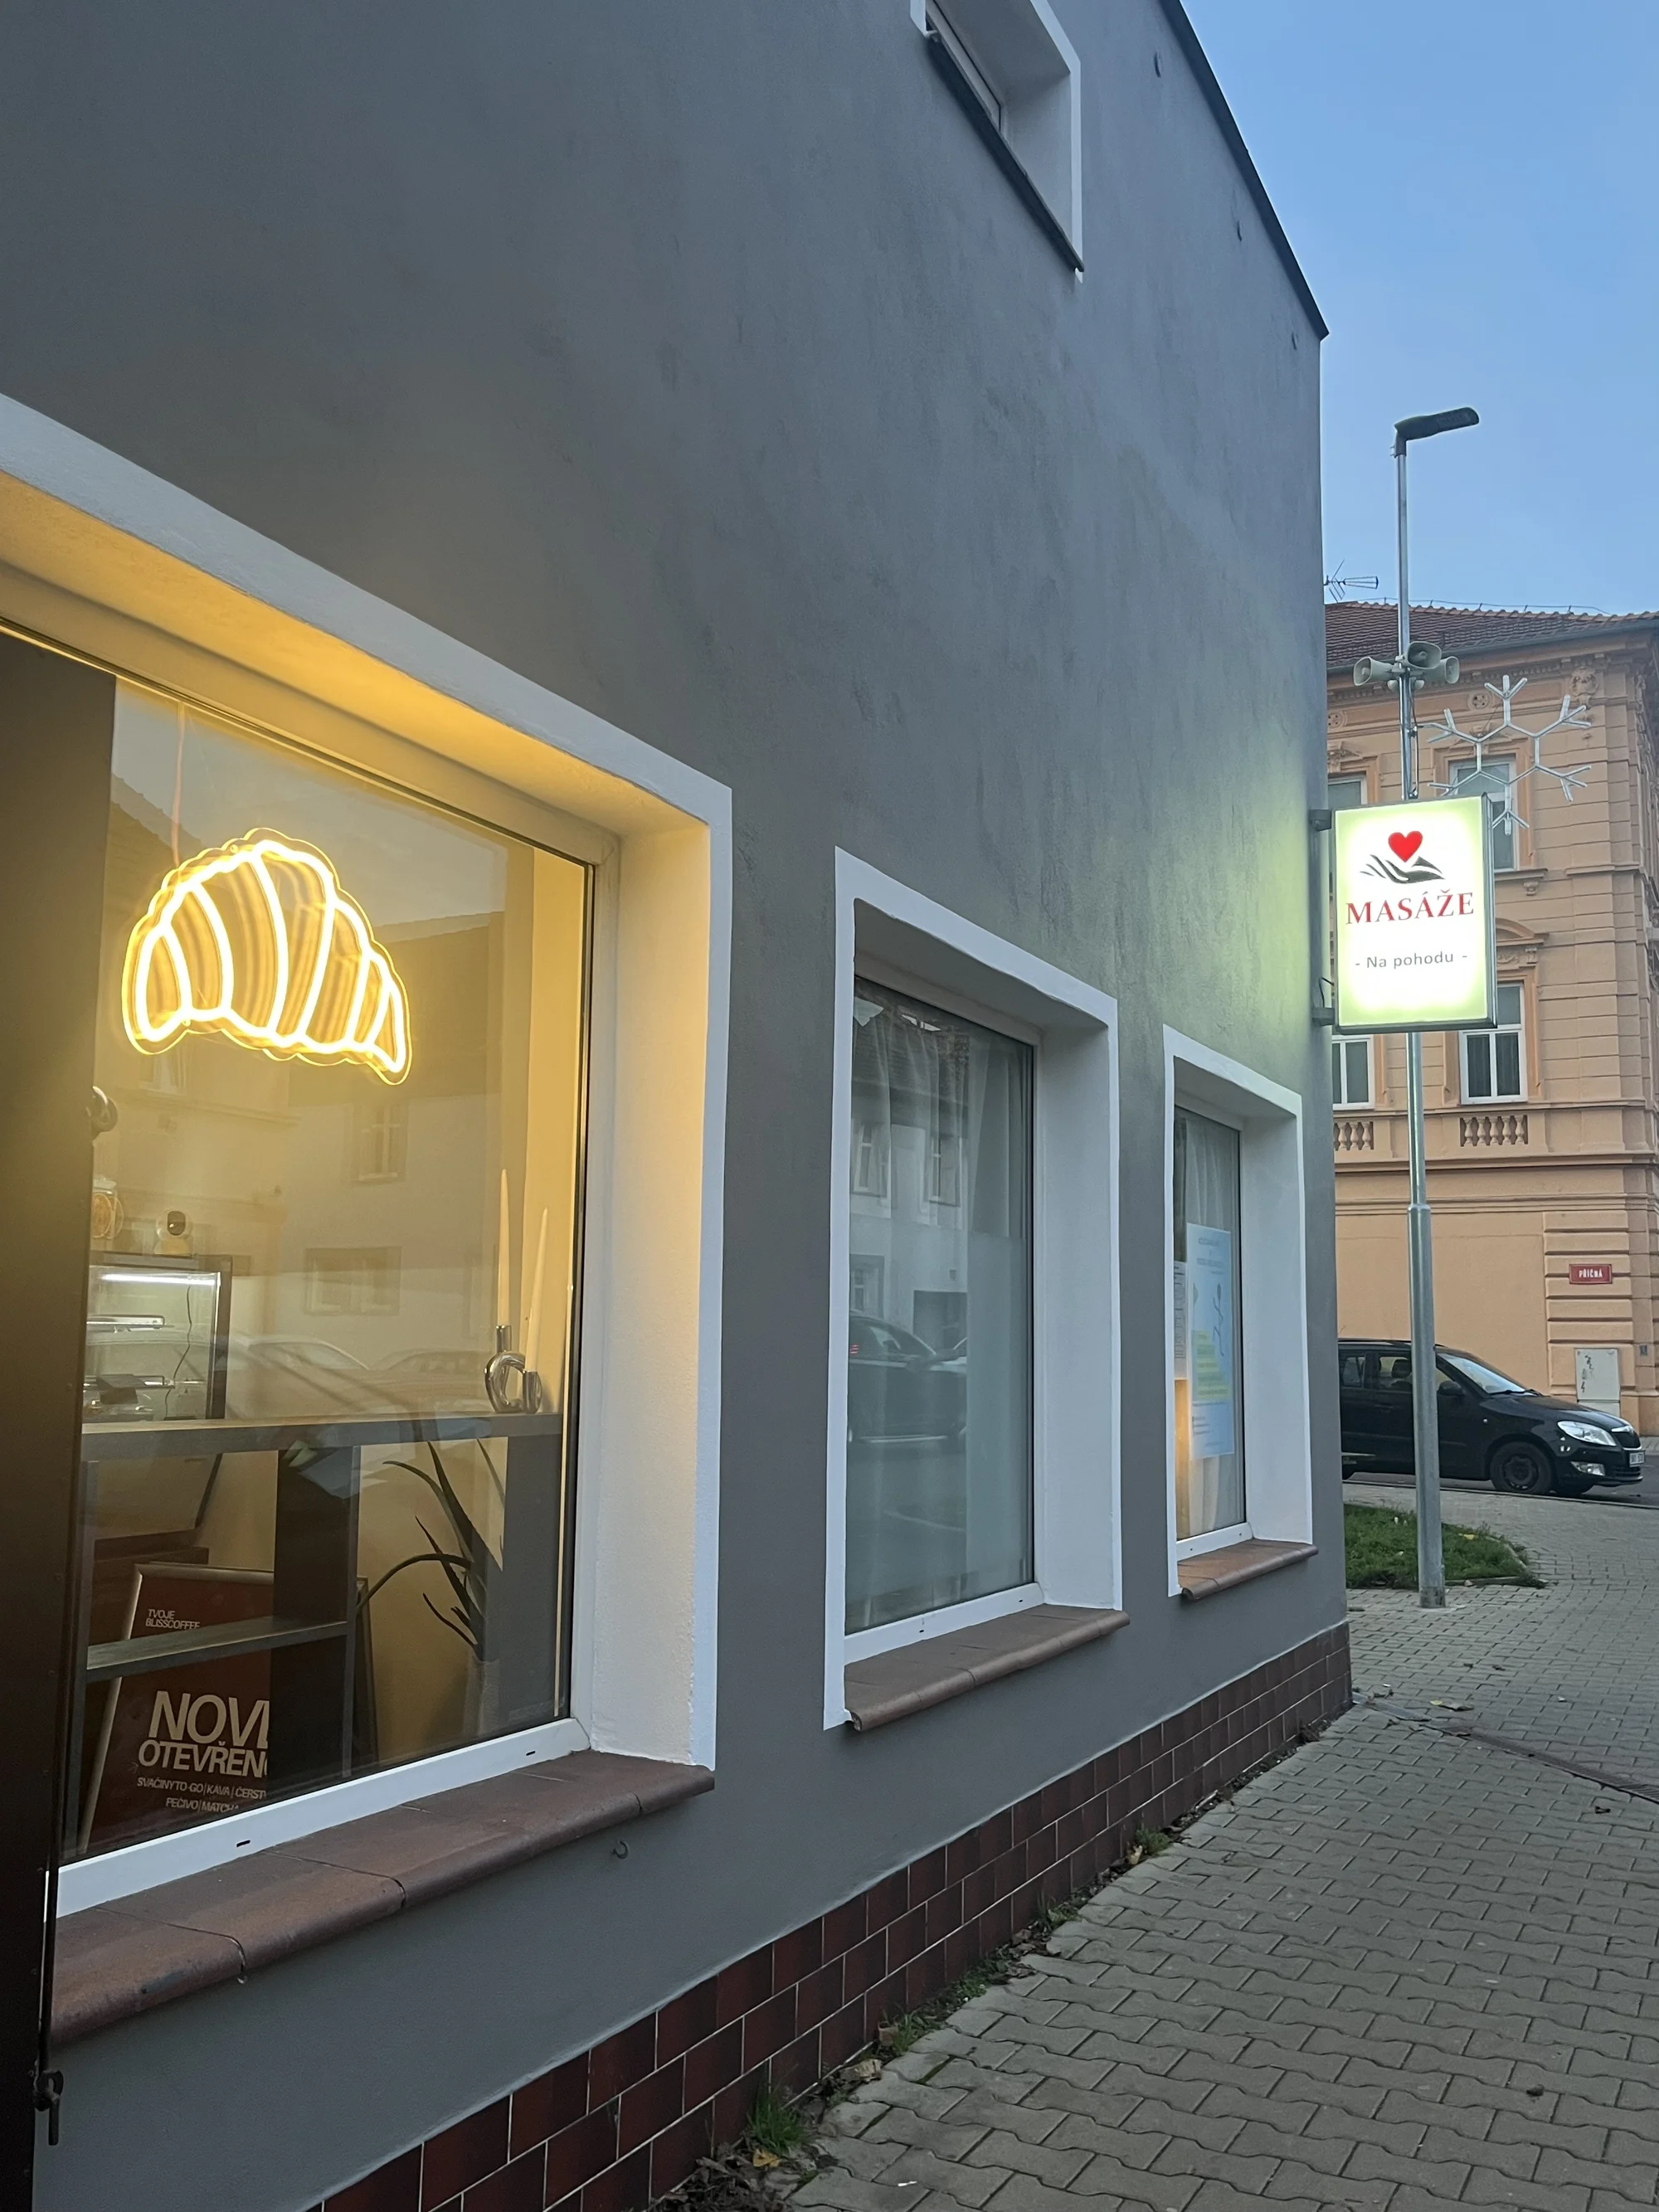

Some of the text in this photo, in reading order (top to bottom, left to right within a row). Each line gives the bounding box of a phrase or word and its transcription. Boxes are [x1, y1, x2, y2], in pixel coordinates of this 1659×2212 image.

[1345, 888, 1474, 925] MASÁŽE
[1366, 955, 1387, 969] Na
[1394, 950, 1453, 970] pohodu
[148, 1609, 175, 1620] TVOJE
[139, 1739, 267, 1778] OTEVŘEN
[137, 1777, 175, 1790] SVAČINY
